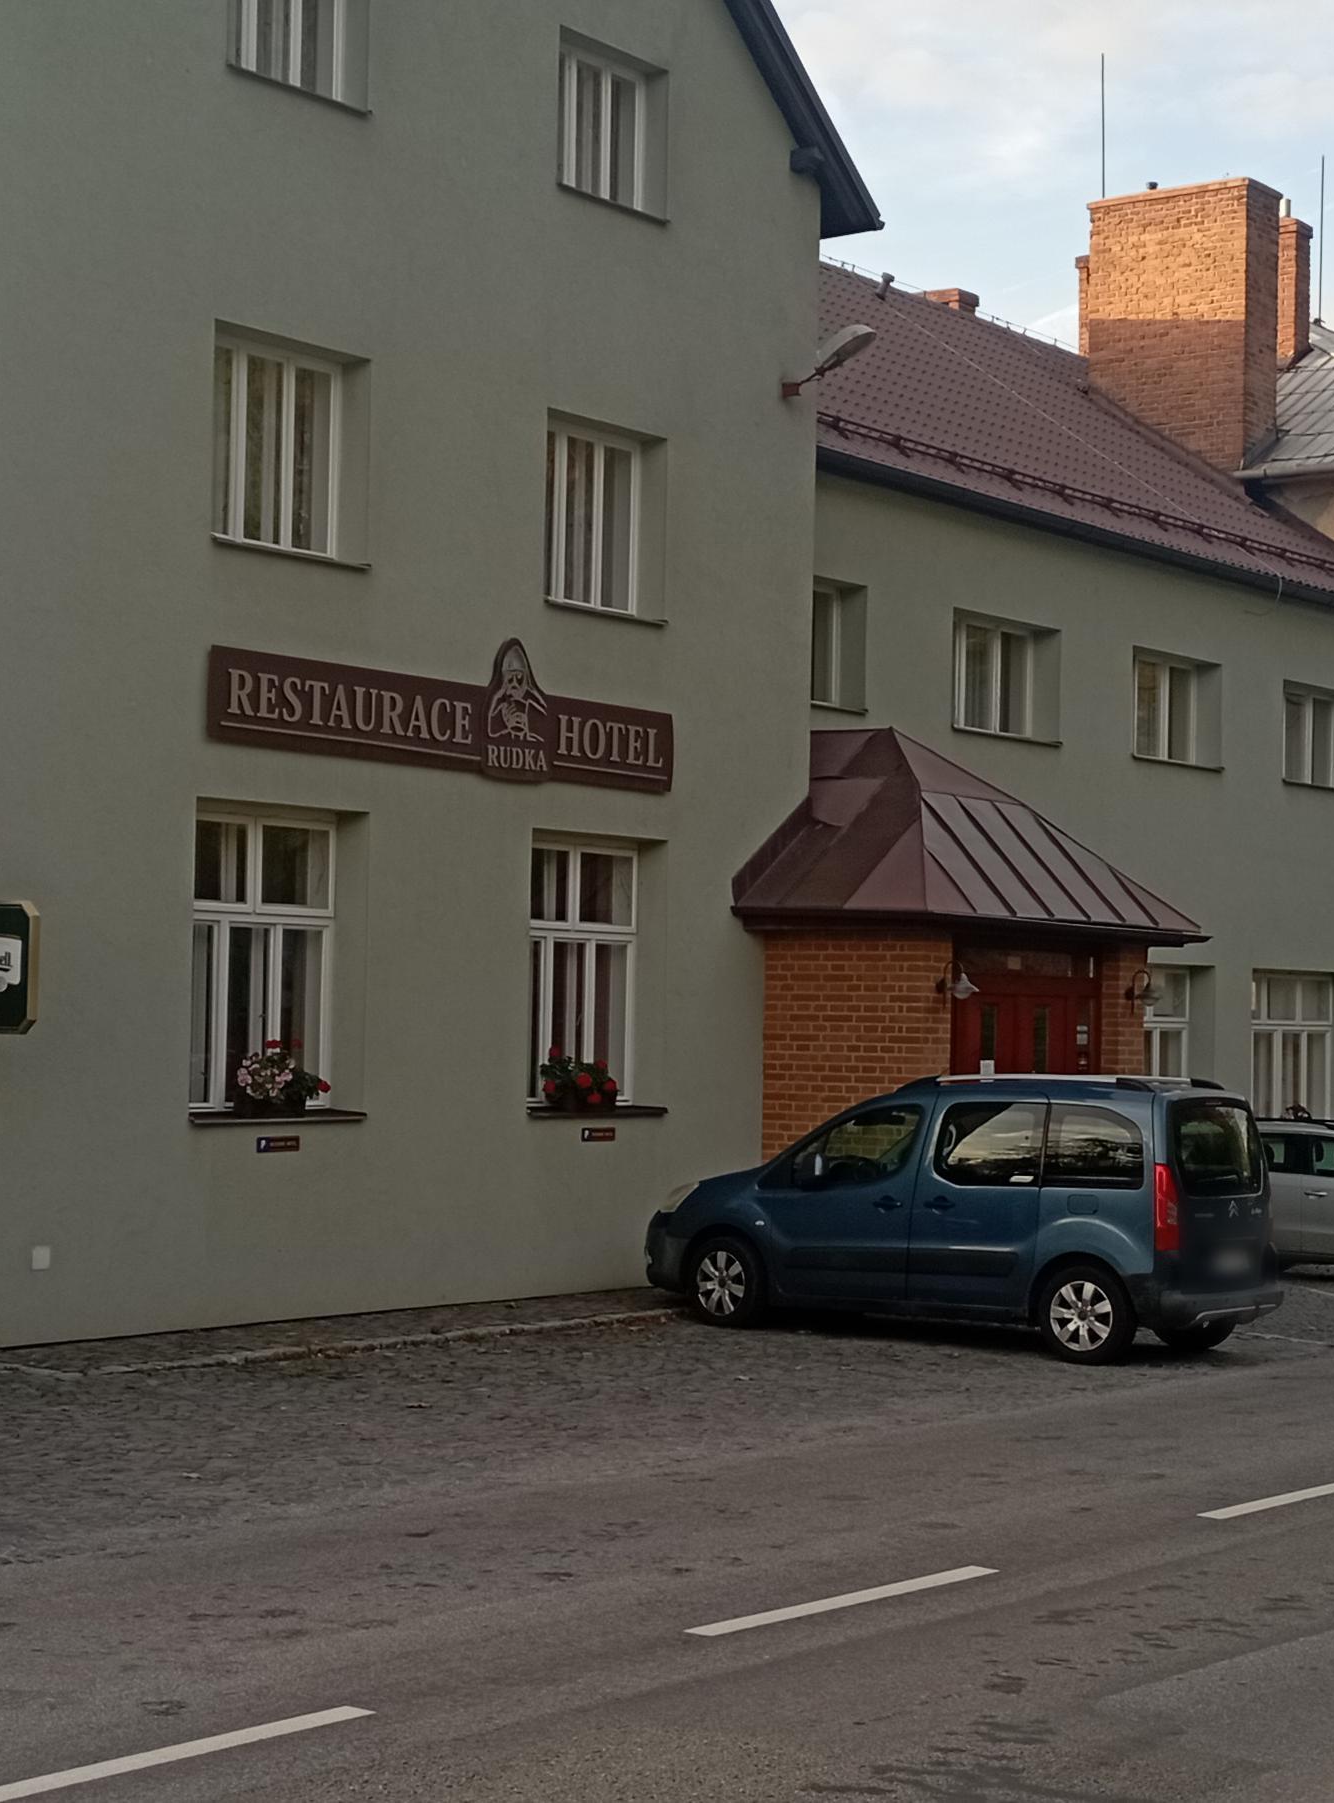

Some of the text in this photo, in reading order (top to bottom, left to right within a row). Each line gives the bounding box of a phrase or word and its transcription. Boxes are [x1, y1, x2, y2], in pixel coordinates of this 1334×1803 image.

[227, 668, 664, 769] RESTAURACE HOTEL
[487, 744, 548, 772] RUDKA
